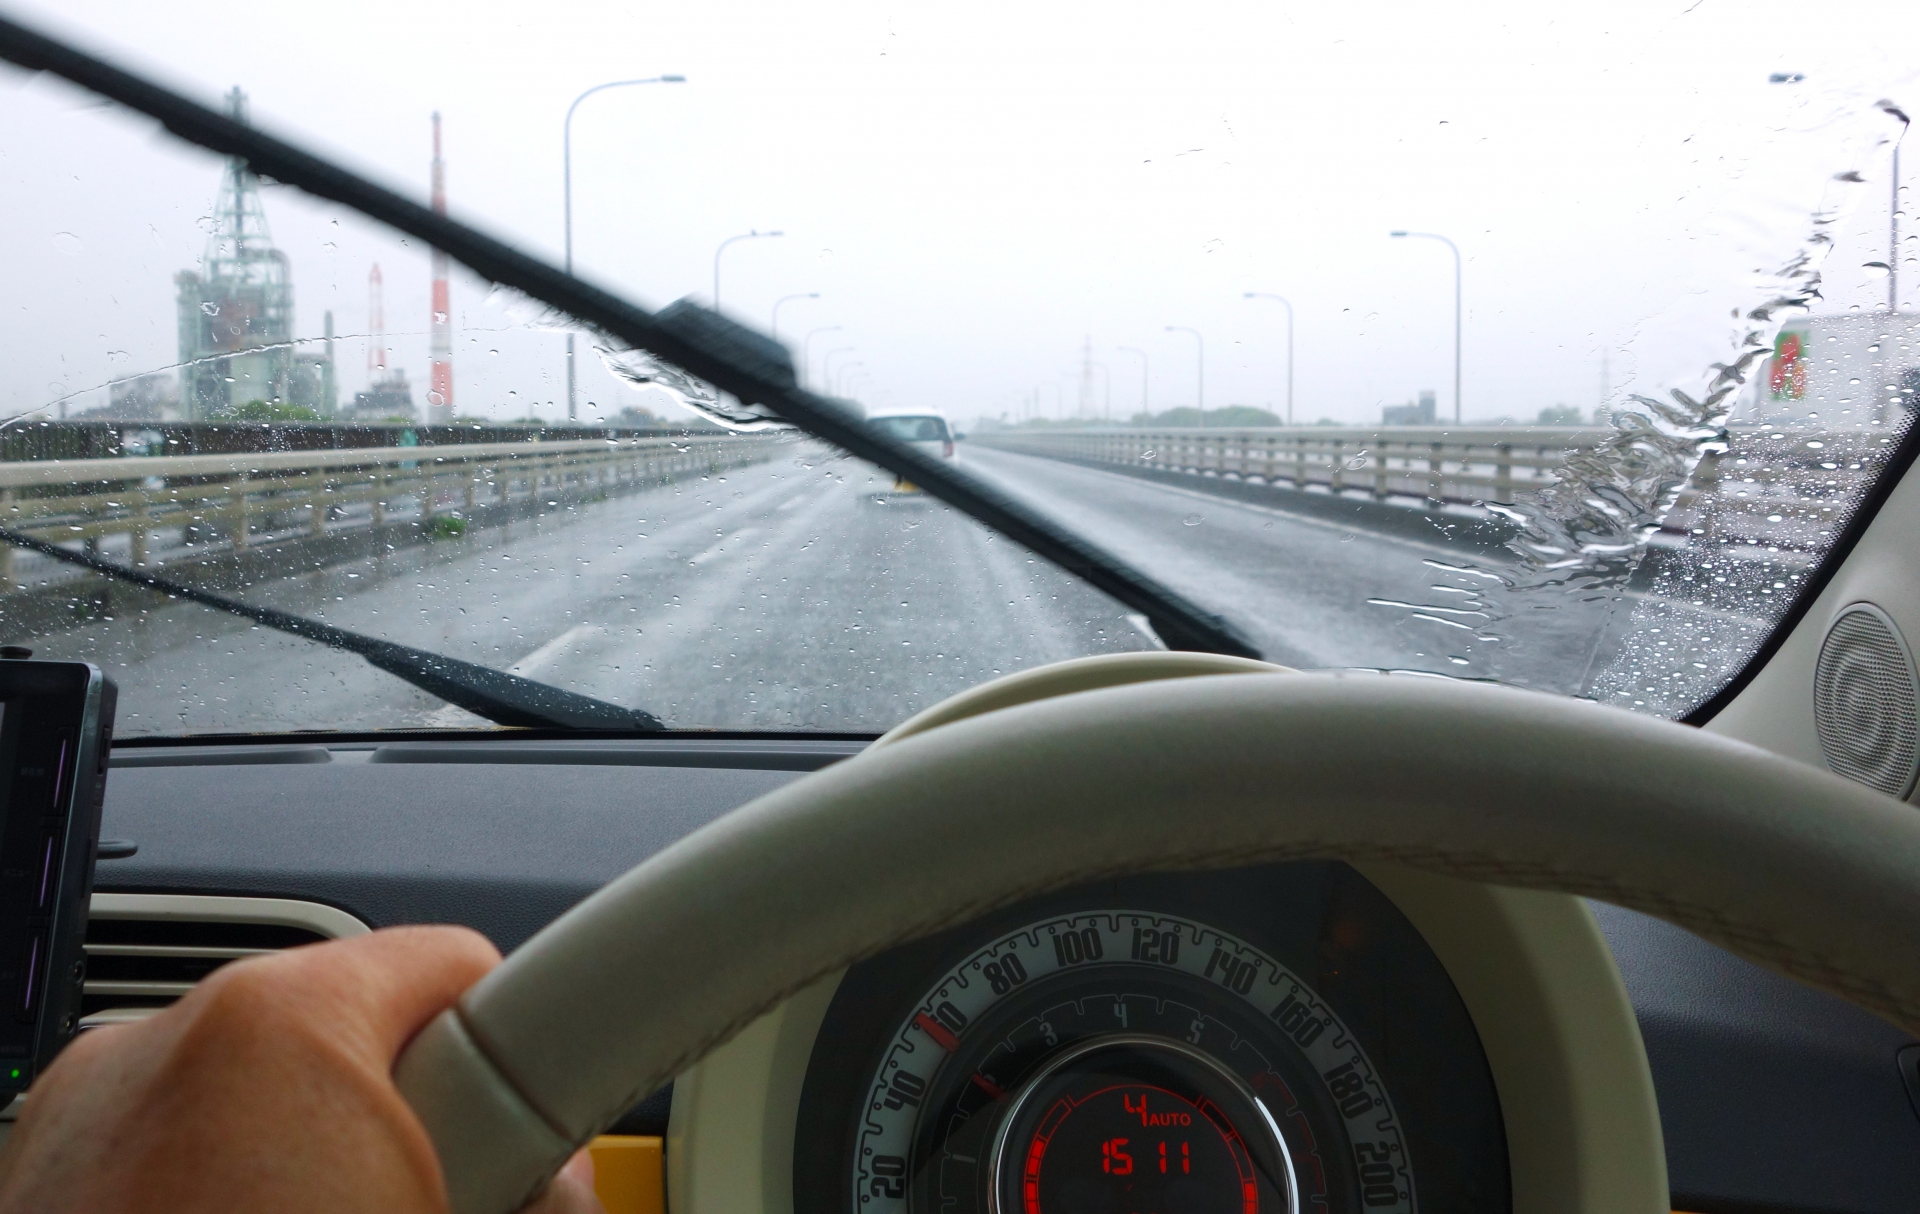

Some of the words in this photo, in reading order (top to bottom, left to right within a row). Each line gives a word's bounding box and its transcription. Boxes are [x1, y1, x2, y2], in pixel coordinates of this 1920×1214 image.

[1053, 927, 1103, 966] 100
[1131, 928, 1179, 965] 120
[984, 952, 1028, 995] 80
[1205, 947, 1260, 996] 140
[1039, 1022, 1059, 1047] 3
[1114, 1003, 1127, 1028] 4
[1187, 1020, 1204, 1044] 5
[1270, 992, 1324, 1048] 160
[884, 1069, 926, 1112] 40
[1123, 1093, 1148, 1128] 4
[1149, 1112, 1192, 1127] AUTO
[1324, 1062, 1370, 1120] 180
[870, 1155, 906, 1199] 20
[1102, 1137, 1133, 1176] 15
[1354, 1141, 1396, 1207] 200
